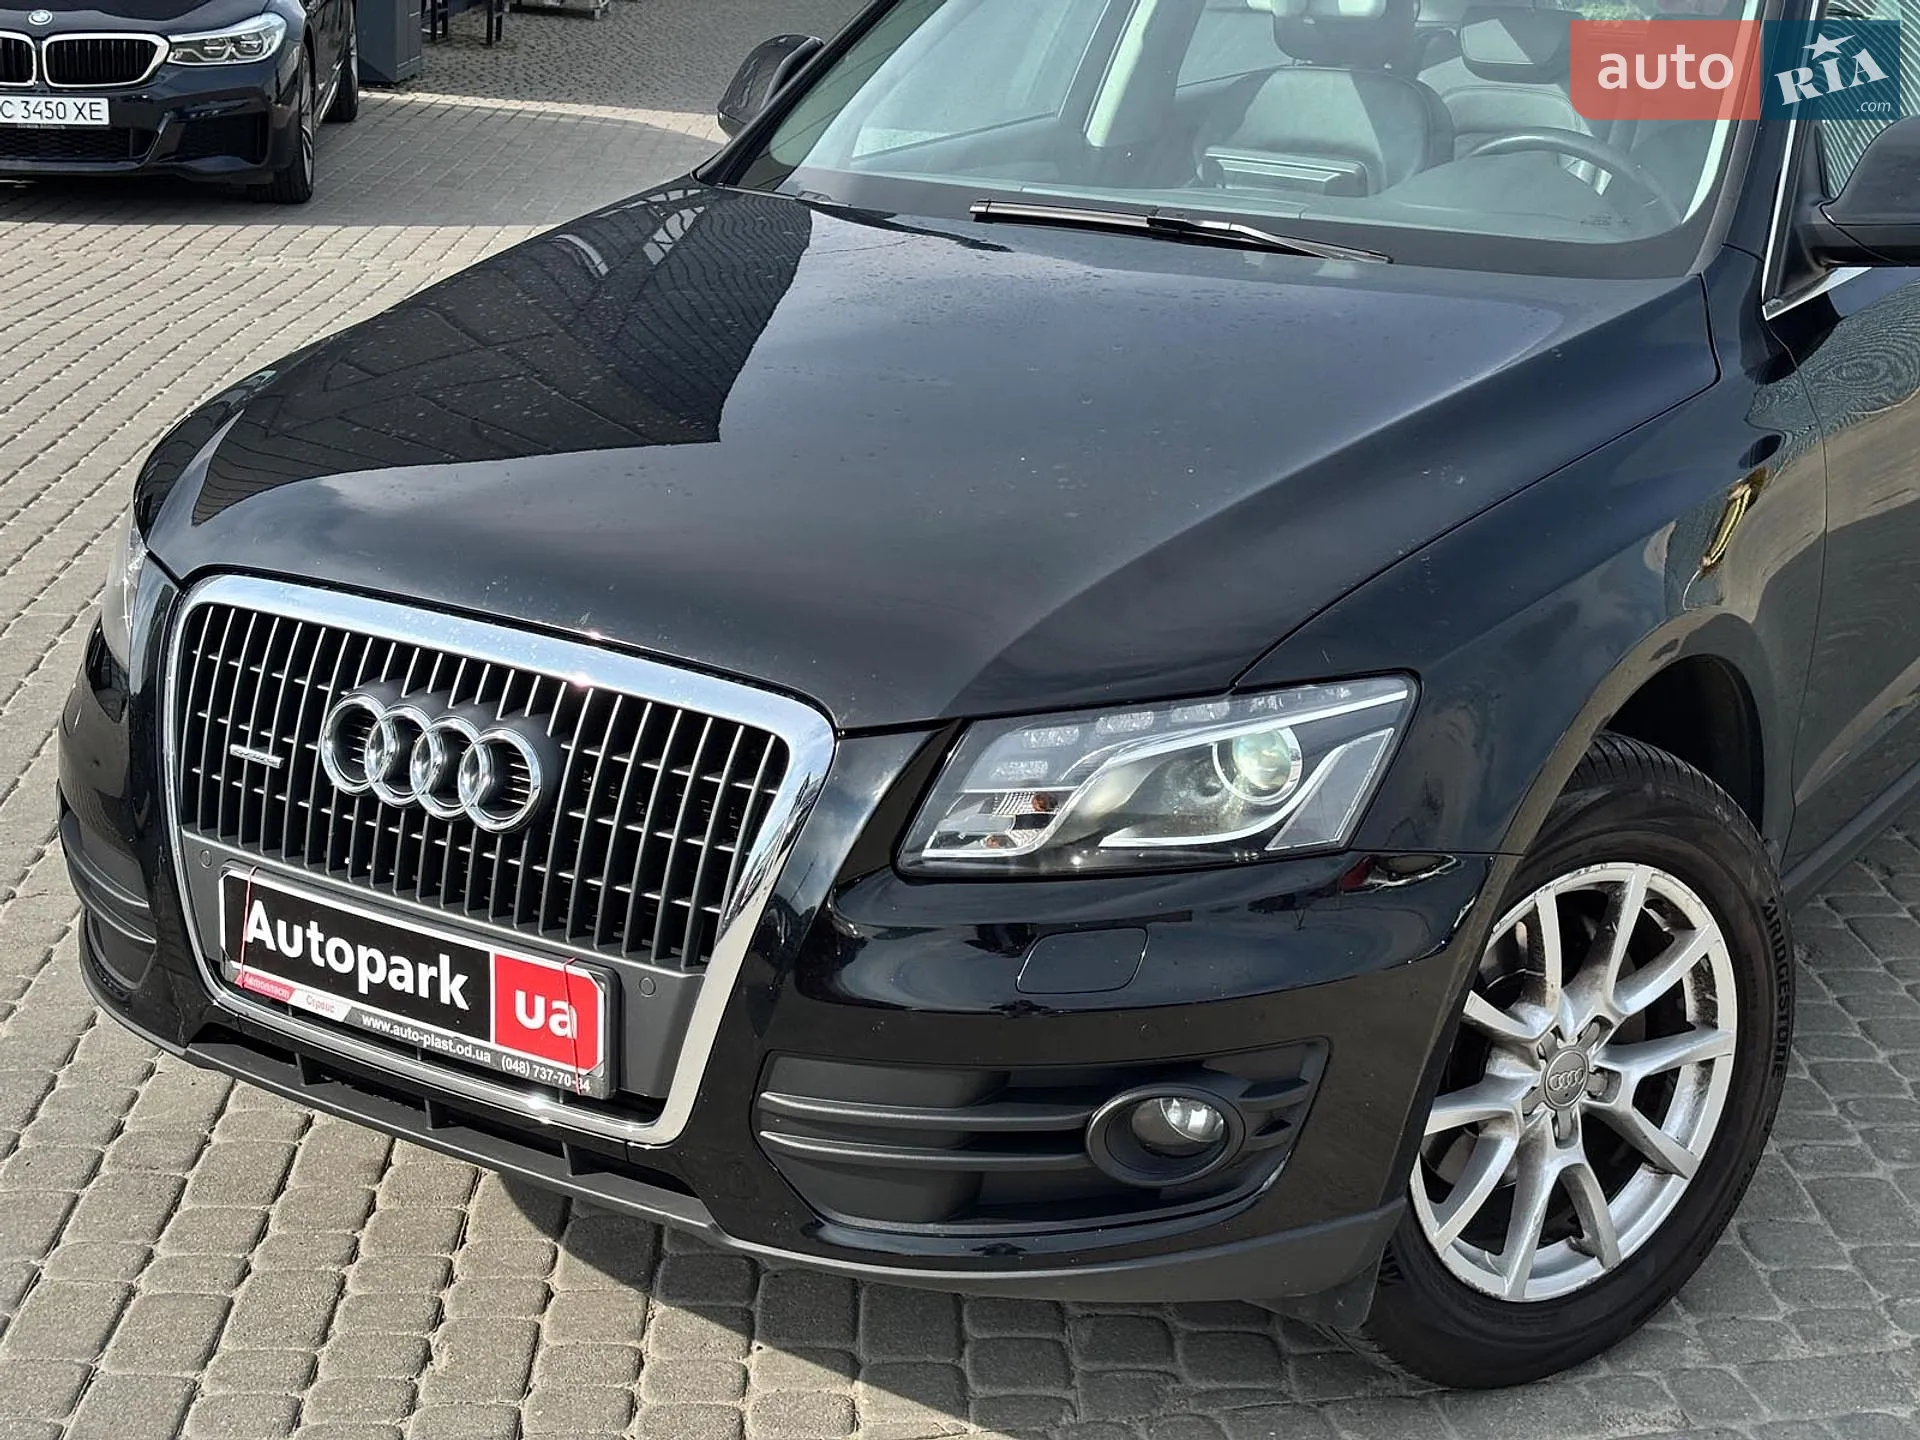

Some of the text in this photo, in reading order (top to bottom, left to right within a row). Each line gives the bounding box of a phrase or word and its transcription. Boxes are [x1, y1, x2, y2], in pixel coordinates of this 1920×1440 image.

[20, 101, 67, 120] 3450
[73, 102, 103, 121] XE
[245, 899, 471, 1011] Autopark
[361, 1014, 492, 1063] www.auto-plast.od.ua
[514, 988, 578, 1040] ua
[501, 1055, 531, 1077] (048)
